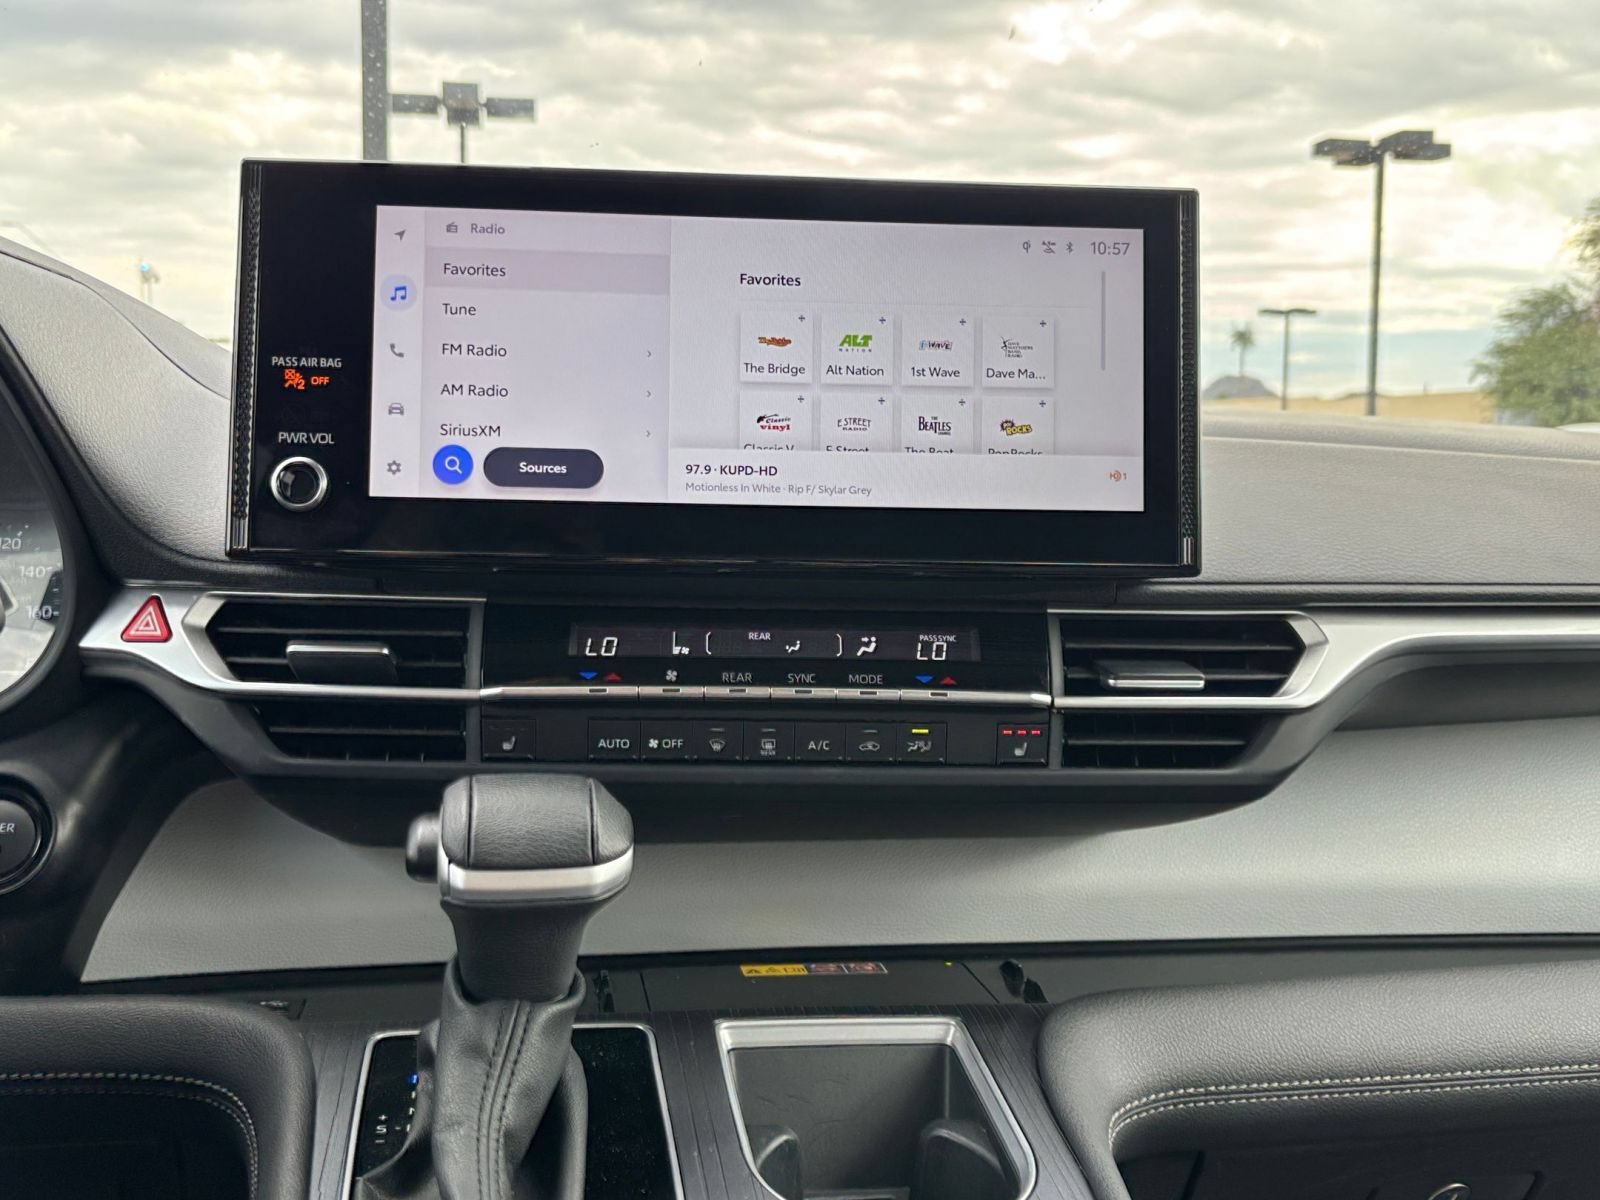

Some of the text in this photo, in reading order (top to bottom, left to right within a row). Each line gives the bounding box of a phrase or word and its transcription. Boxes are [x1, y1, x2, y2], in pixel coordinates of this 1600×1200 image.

[470, 223, 505, 235] Radio
[1090, 241, 1130, 256] 10:57
[443, 263, 506, 277] Favorites
[740, 273, 801, 287] Favorites
[442, 303, 477, 316] Tune
[839, 334, 872, 347] ALT
[441, 343, 507, 358] FM Radio
[271, 356, 342, 368] PASS AIR BAG
[743, 362, 806, 376] The Bridge
[826, 364, 884, 376] Alt Nation
[911, 366, 960, 378] 1st Wave
[986, 367, 1046, 380] Dave Ma...
[310, 376, 330, 385] OFF
[440, 383, 508, 398] AM Radio
[760, 424, 790, 432] vinyl
[844, 417, 871, 428] STREET
[439, 423, 501, 437] SiriusXM
[278, 431, 335, 444] PWR VOL
[519, 461, 567, 475] Sources
[685, 464, 778, 476] 97.9 KUPD-HD
[685, 482, 872, 497] Motionless In White Rip F/ Skylar Grey
[19, 565, 46, 578] 140
[26, 605, 52, 620] 160
[748, 632, 771, 640] REAR
[919, 634, 957, 642] PASS SYNC
[585, 636, 618, 656] LO
[917, 641, 947, 661] LO
[722, 672, 752, 683] REAR
[787, 673, 816, 683] SYNC
[848, 674, 883, 685] MODE
[598, 738, 630, 749] AUTO
[662, 738, 684, 749] OFF
[807, 739, 830, 751] A/C
